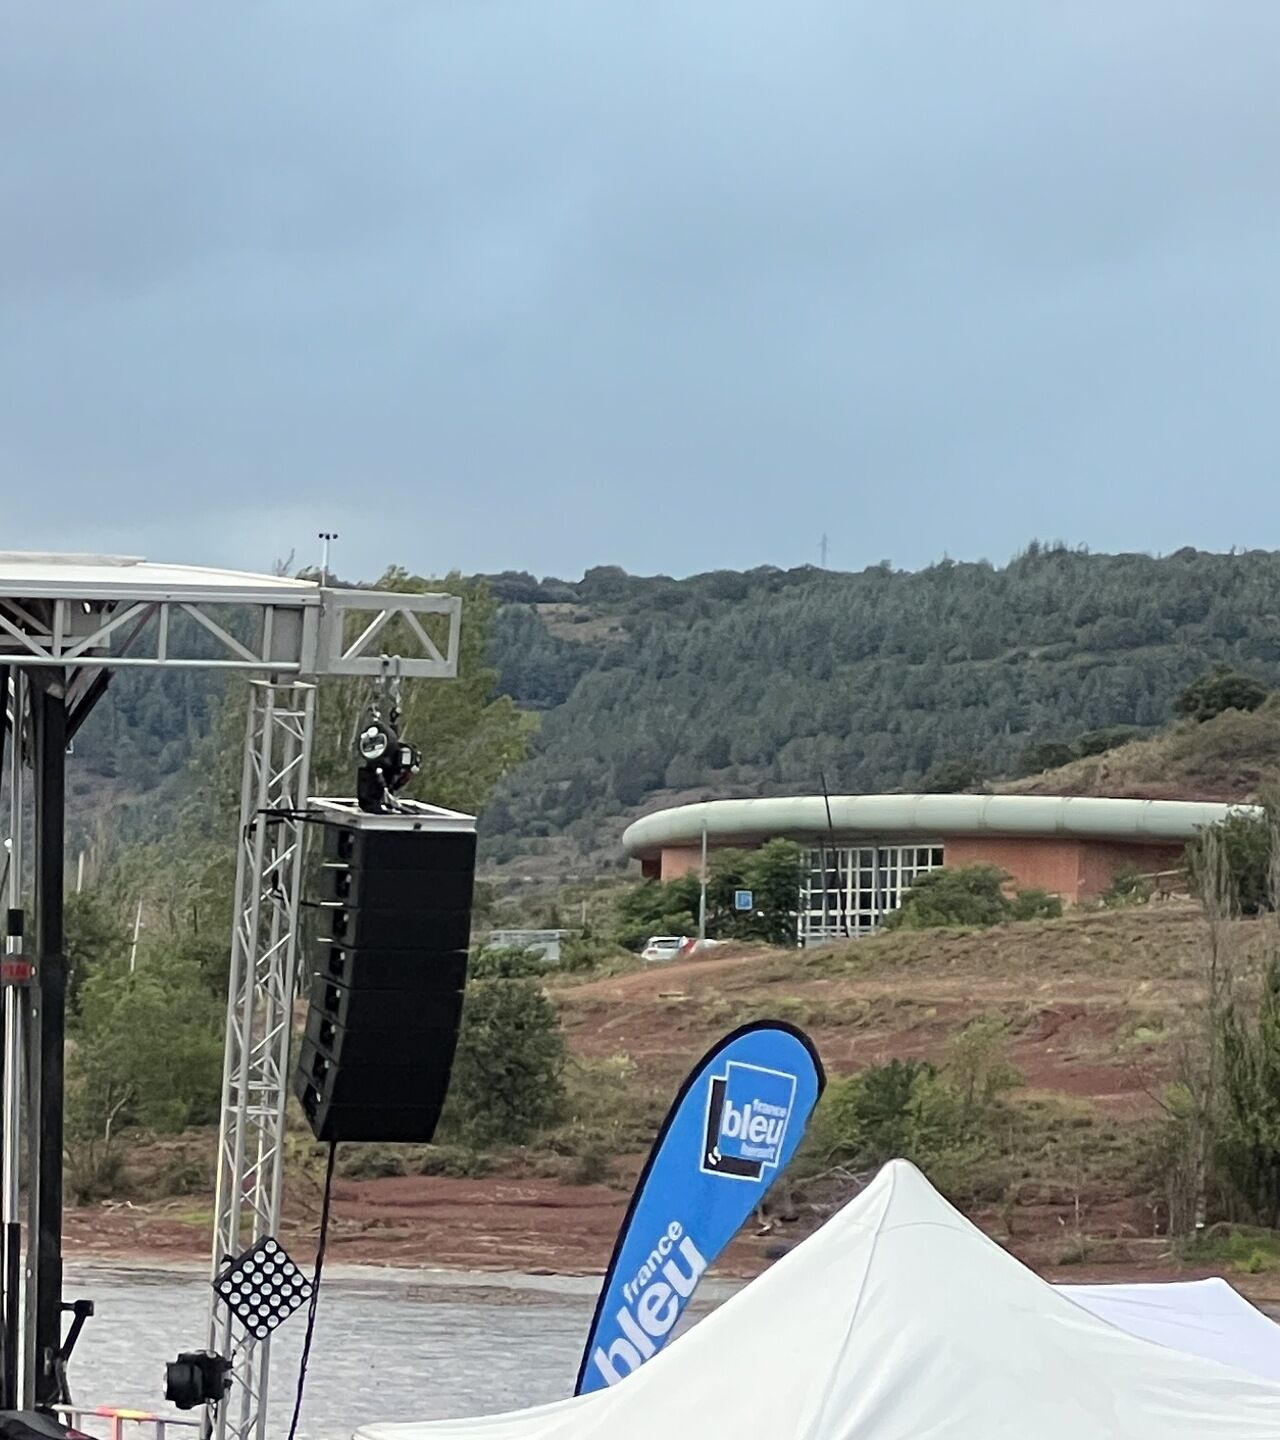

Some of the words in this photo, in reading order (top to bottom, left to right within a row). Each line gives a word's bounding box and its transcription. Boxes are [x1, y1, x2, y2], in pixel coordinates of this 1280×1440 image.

[721, 1100, 784, 1145] bleu
[622, 1220, 683, 1304] france
[593, 1235, 708, 1377] bleu
